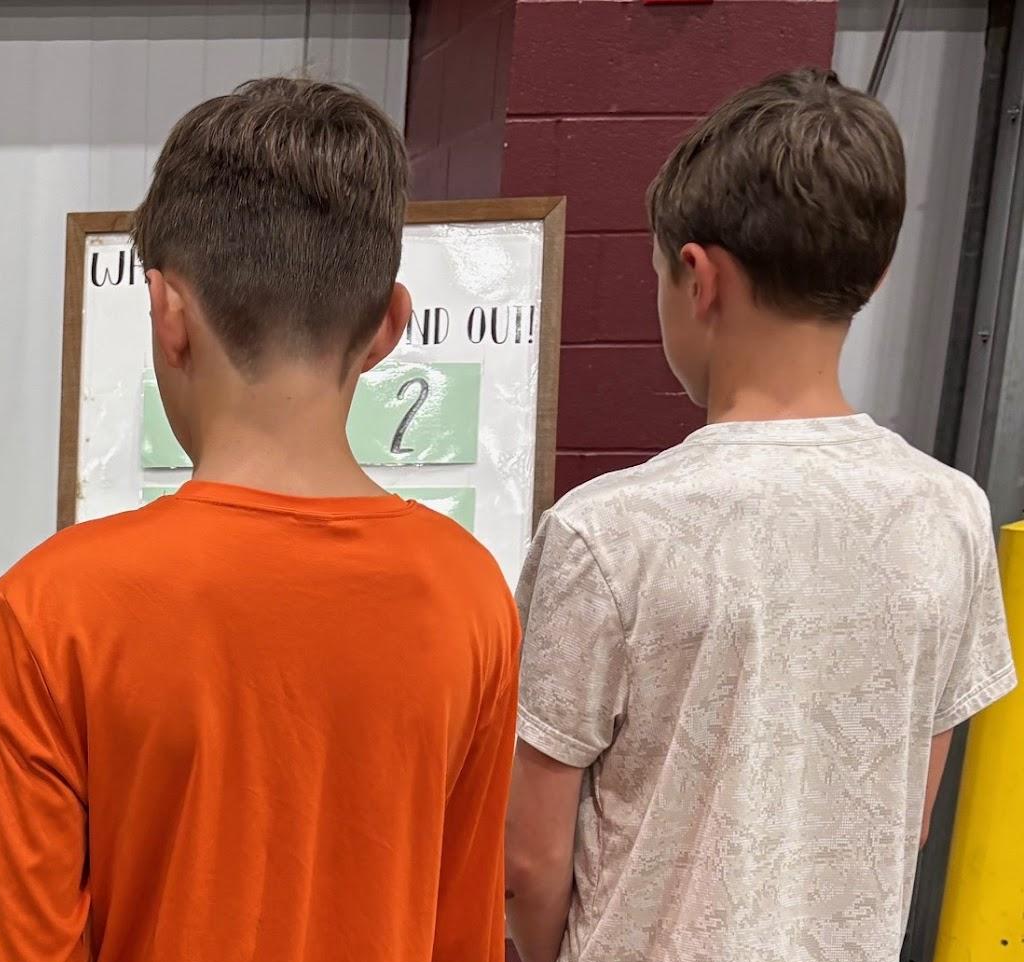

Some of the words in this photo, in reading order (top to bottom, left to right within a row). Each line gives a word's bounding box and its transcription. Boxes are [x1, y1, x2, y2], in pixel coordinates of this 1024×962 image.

[91, 249, 148, 288] WH
[406, 307, 450, 345] ND
[467, 305, 535, 345] OUT!
[390, 377, 429, 454] 2
